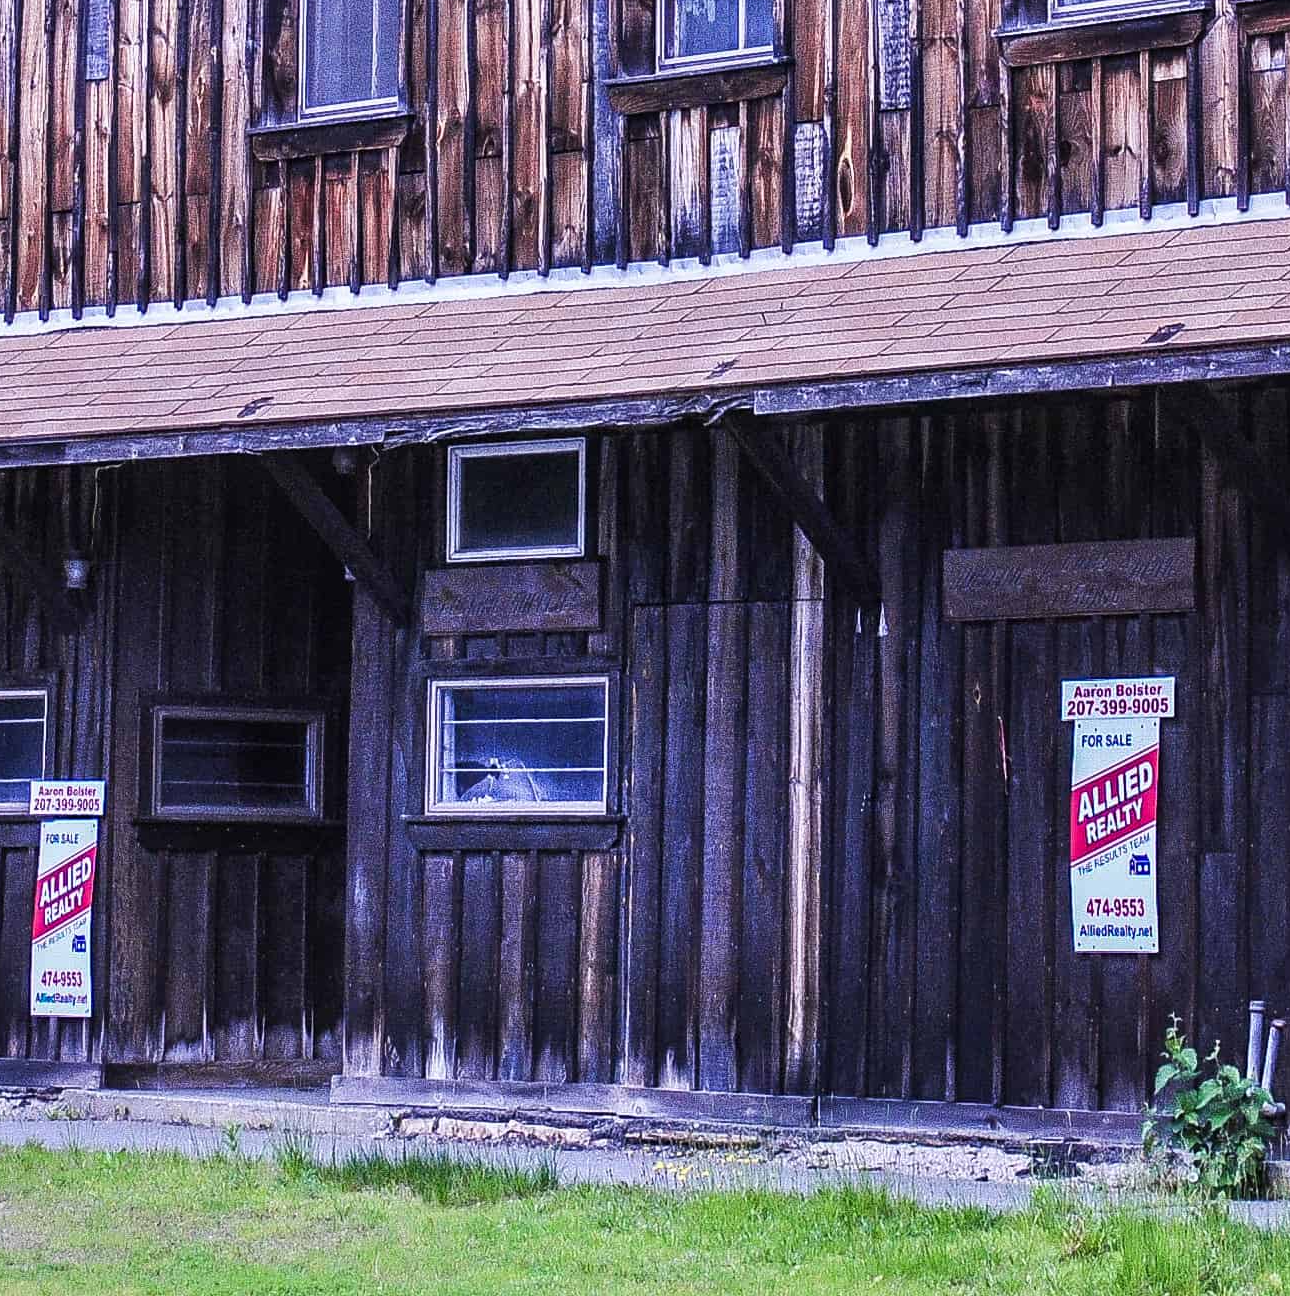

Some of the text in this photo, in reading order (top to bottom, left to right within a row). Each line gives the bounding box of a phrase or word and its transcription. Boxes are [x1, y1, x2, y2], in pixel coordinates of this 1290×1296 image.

[1074, 684, 1163, 699] Aaron Bolster
[1067, 697, 1169, 717] 207-399-9005
[1081, 734, 1132, 748] FOR SALE
[38, 785, 97, 797] Aaron Bolster
[1077, 761, 1154, 823] ALLIED
[34, 798, 100, 812] 207-399-9005
[1086, 799, 1144, 845] REALTY
[45, 833, 79, 845] FOR SALE
[1078, 833, 1150, 877] THE RESULTS TEAM
[39, 856, 92, 908] ALLIED
[44, 888, 84, 925] REALTY
[1086, 898, 1145, 917] 474-9553
[1079, 925, 1153, 940] AlliedRealty.net
[41, 971, 83, 987] 474-9553
